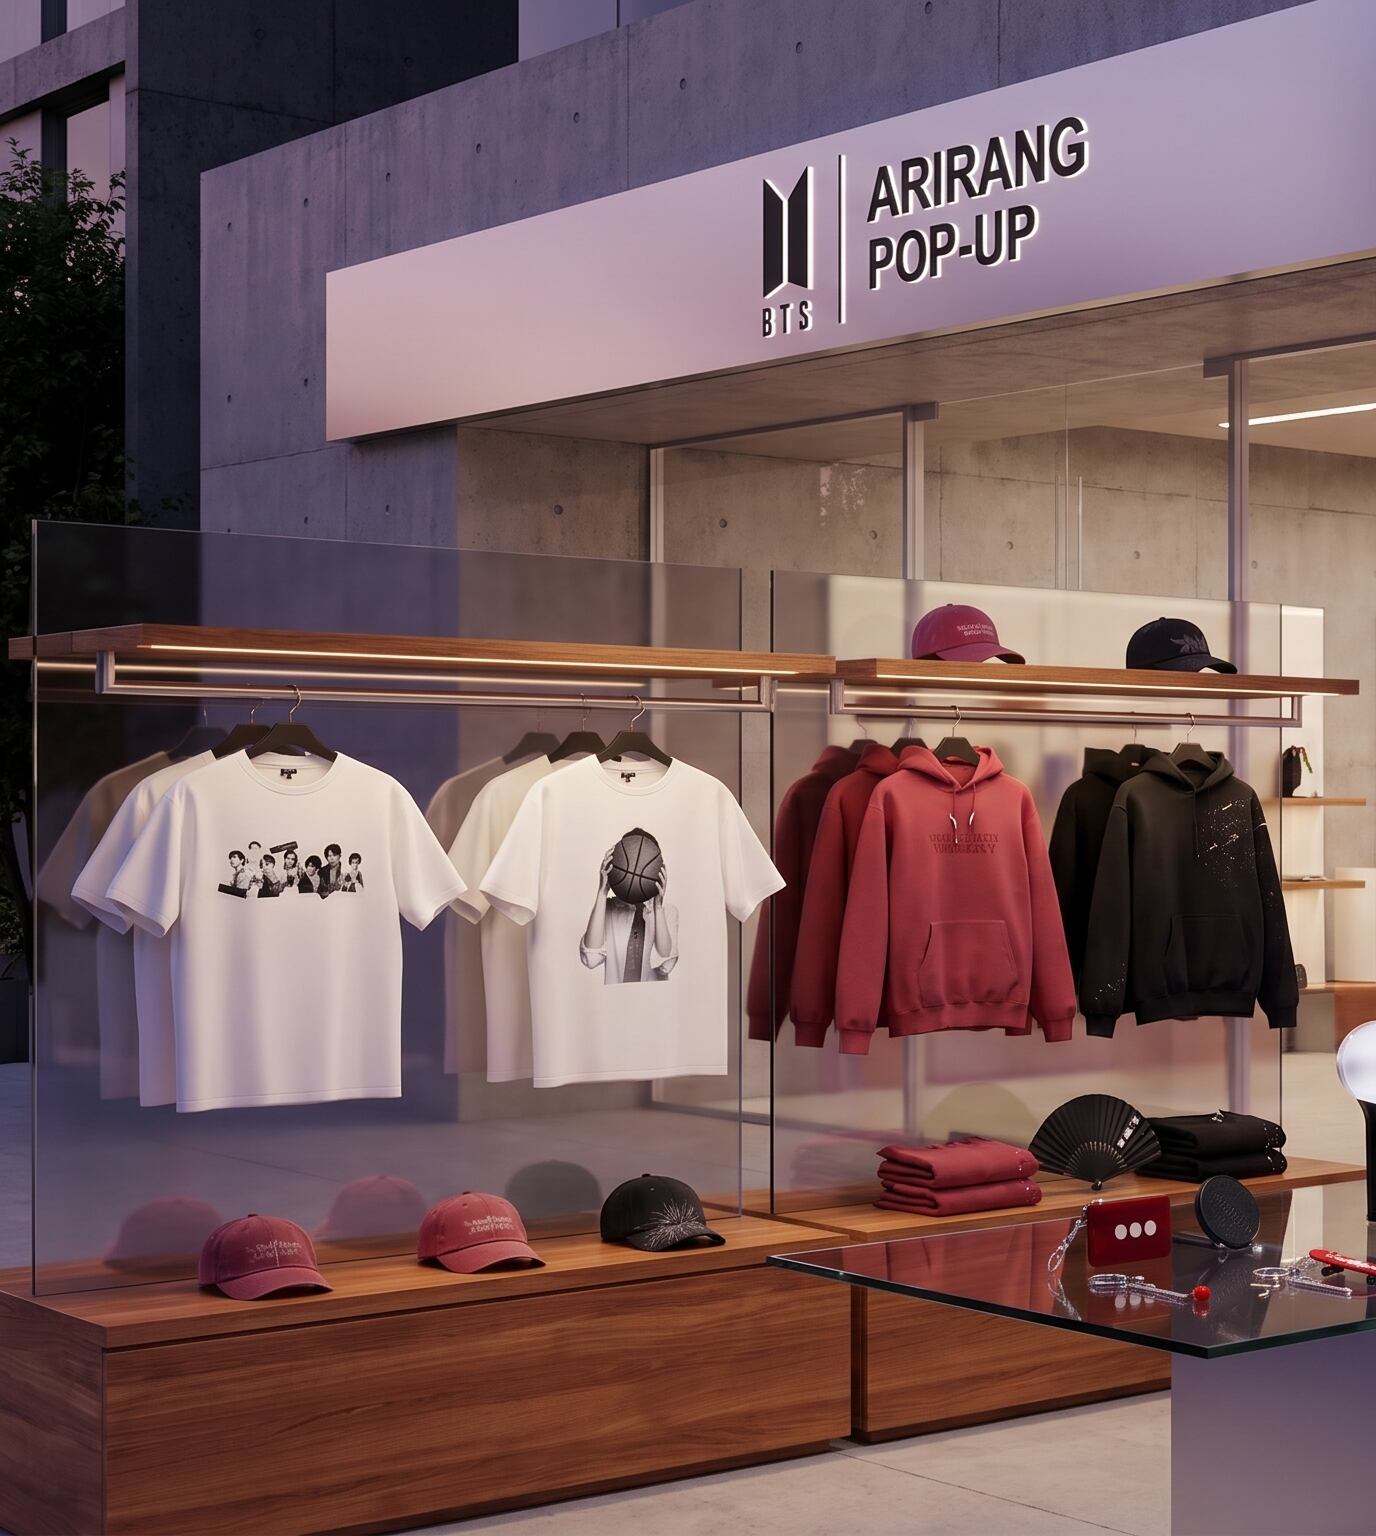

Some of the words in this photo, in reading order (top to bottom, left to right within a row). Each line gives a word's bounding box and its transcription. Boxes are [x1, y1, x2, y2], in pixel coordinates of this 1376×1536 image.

[867, 116, 1087, 222] ARIRANG
[870, 204, 1038, 289] POP-UP
[763, 301, 811, 337] BTS
